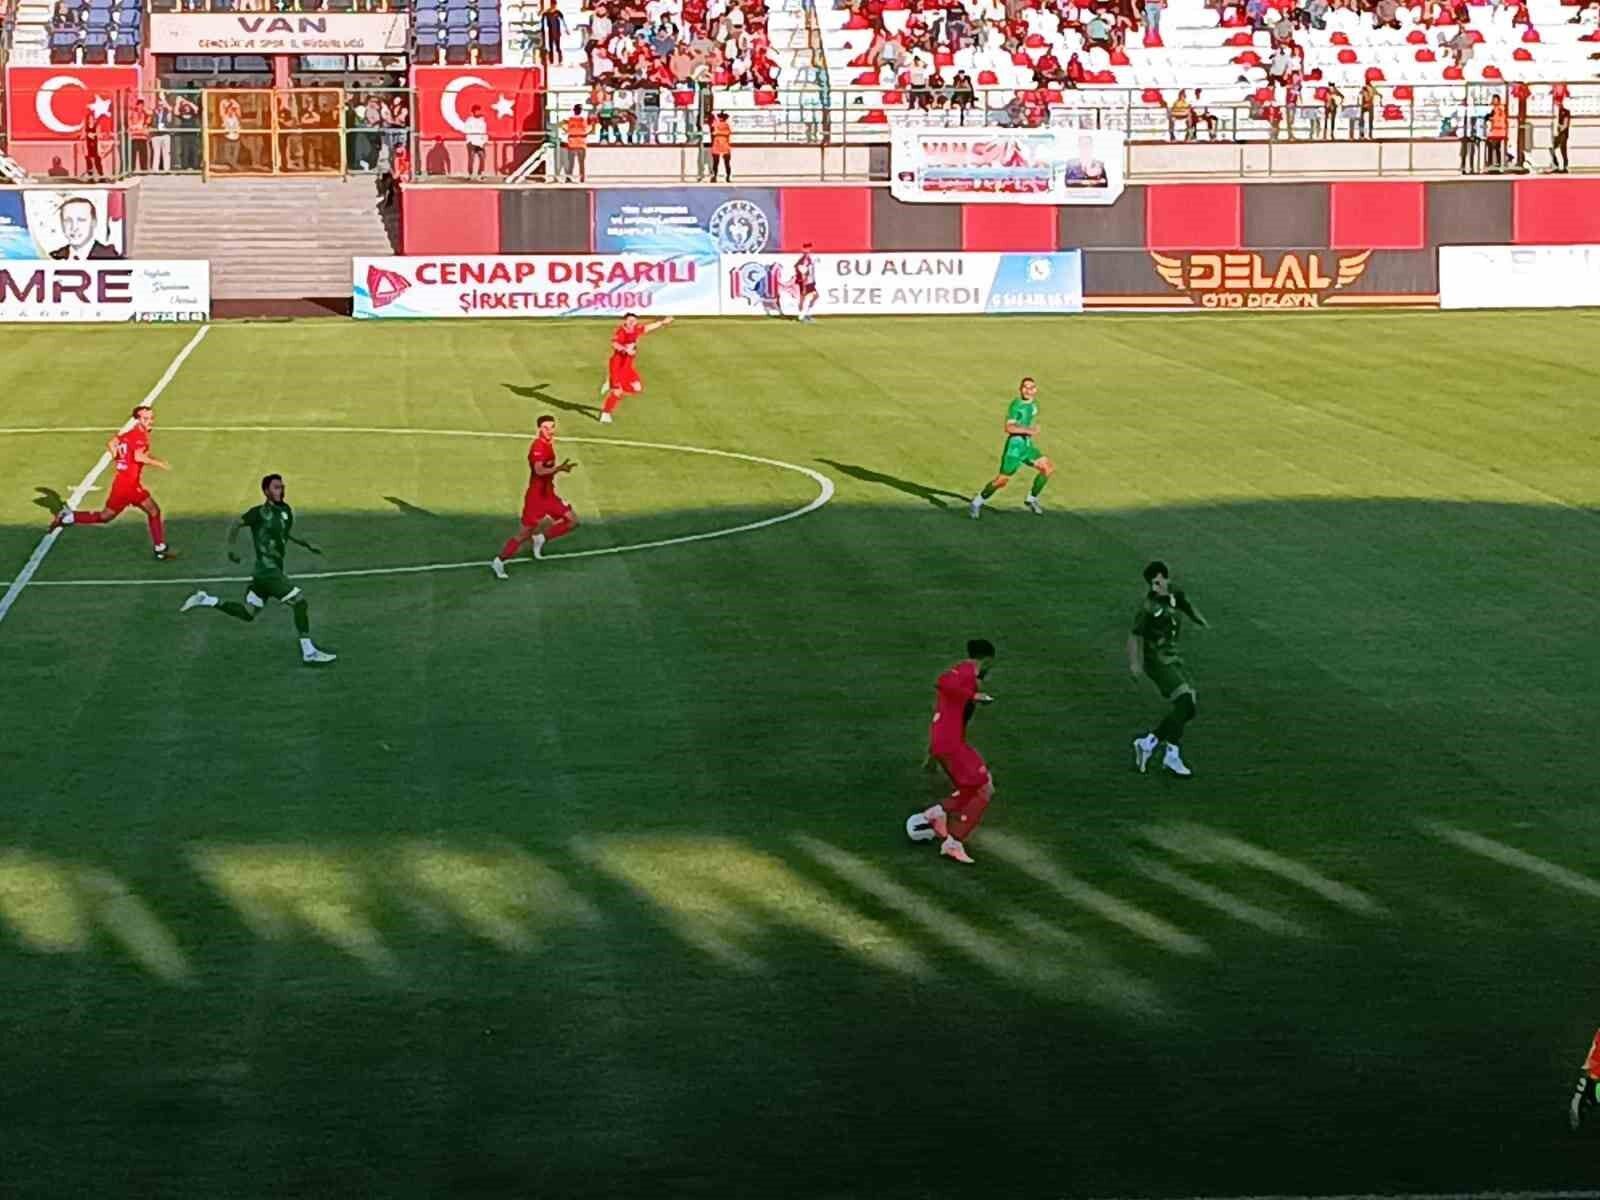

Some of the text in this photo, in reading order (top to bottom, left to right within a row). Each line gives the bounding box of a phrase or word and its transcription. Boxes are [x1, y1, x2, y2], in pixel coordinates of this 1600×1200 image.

[237, 17, 327, 33] VAN
[415, 260, 696, 288] CENAP DIŞARILI
[836, 258, 964, 276] BU ALANI
[1189, 254, 1332, 289] DELAL
[459, 289, 653, 312] ŞİRKETLER GRUBU
[827, 286, 883, 305] SİZE
[891, 287, 980, 305] AYIRDI
[1202, 293, 1243, 307] OTO
